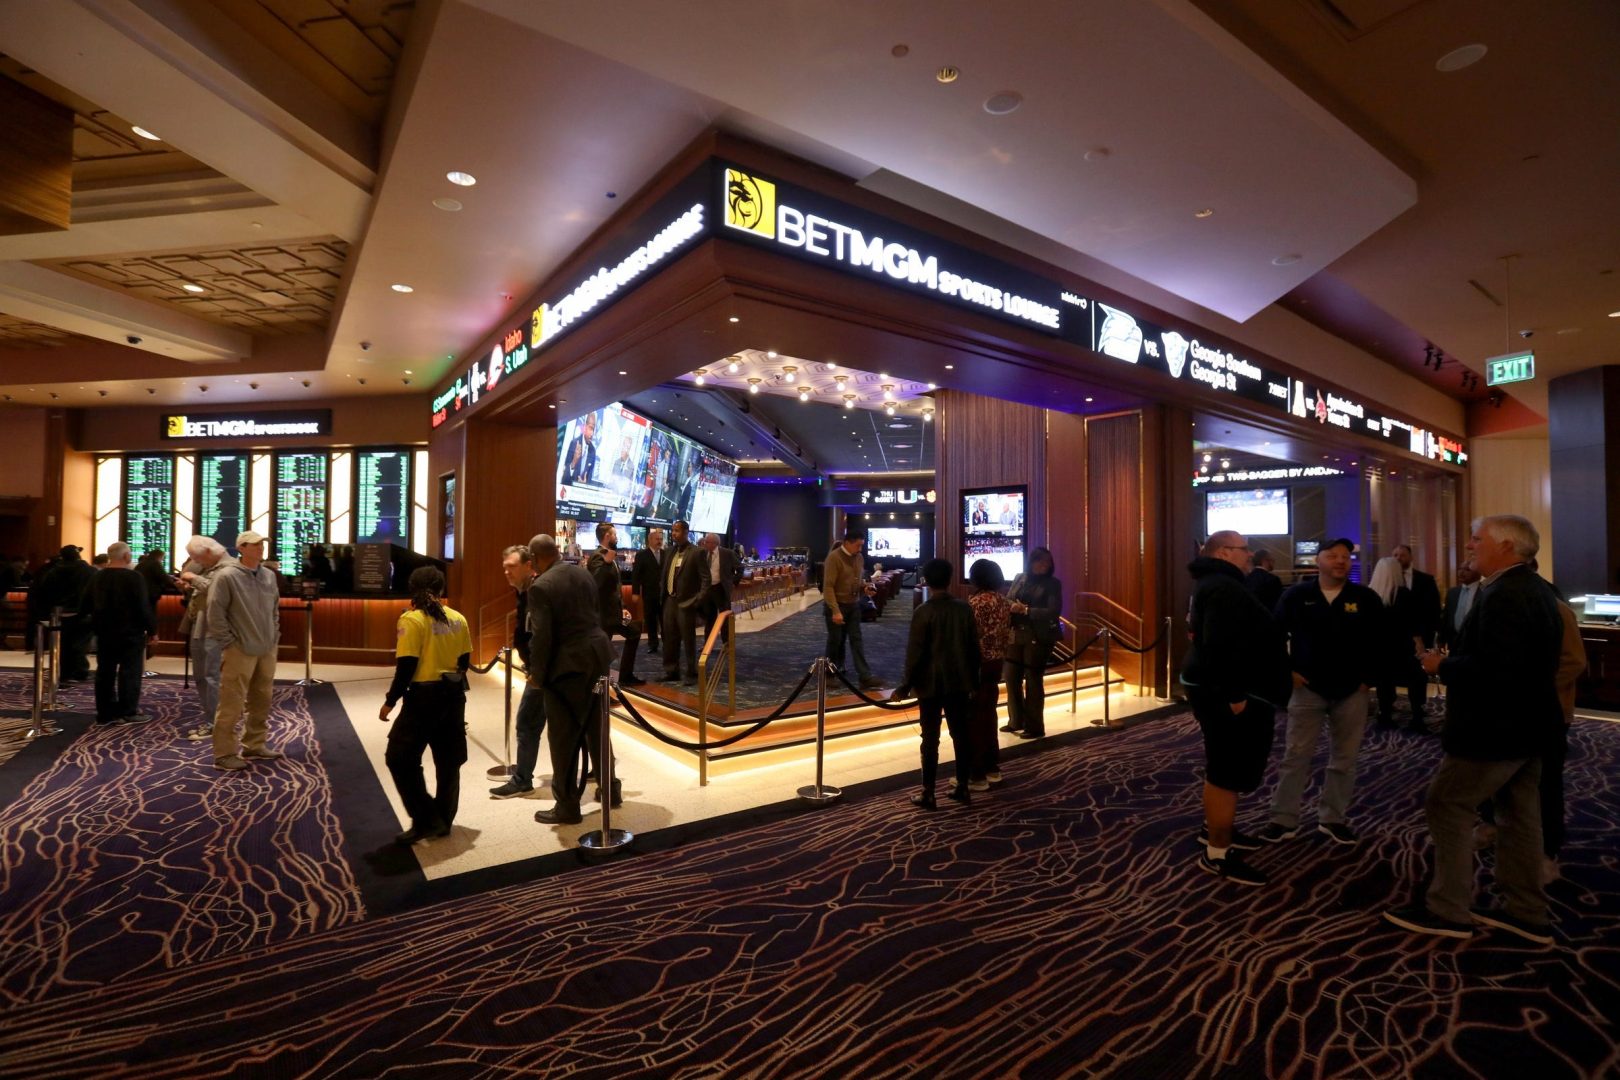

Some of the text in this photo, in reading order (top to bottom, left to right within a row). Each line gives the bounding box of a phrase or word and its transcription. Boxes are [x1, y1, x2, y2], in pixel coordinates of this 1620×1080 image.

[777, 204, 938, 289] BETMGM
[938, 270, 1003, 311] SPORTS
[505, 329, 523, 353] Idaho
[512, 344, 528, 369] Utah
[1190, 339, 1226, 369] Georgia
[1190, 360, 1226, 390] Georgia
[1493, 359, 1528, 383] EXIT
[186, 420, 254, 437] BETMGM
